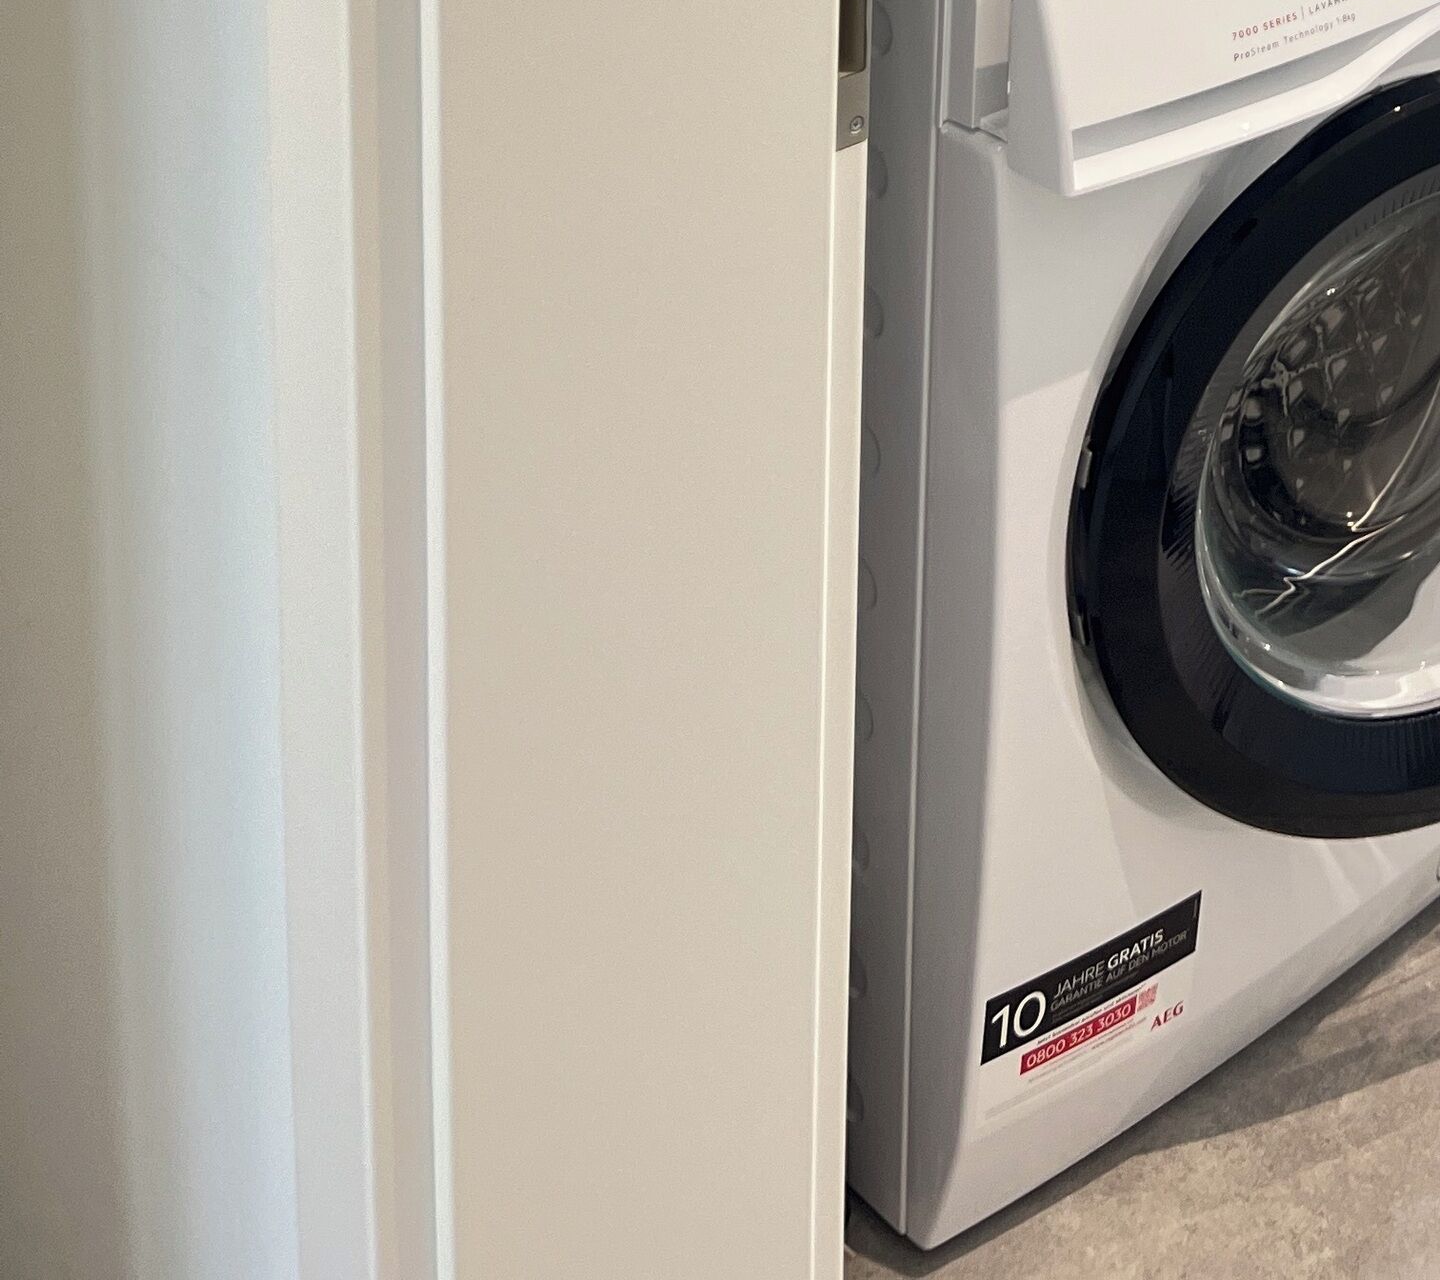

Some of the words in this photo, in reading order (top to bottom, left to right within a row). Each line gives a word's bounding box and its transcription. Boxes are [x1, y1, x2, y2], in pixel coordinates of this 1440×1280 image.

[1232, 25, 1259, 41] 7000
[1263, 12, 1298, 32] SERIES
[1233, 42, 1280, 62] ProSteam
[1284, 22, 1334, 45] Technology
[1051, 980, 1103, 1011] GARANTIE
[1105, 965, 1128, 983] AUF
[1128, 953, 1150, 971] DEN
[1152, 931, 1188, 959] MOTOR
[1053, 960, 1106, 999] JAHRE
[1107, 928, 1164, 970] GRATIS
[991, 991, 1046, 1049] 10
[1026, 1039, 1066, 1069] 0800
[1069, 1024, 1094, 1047] 323
[1097, 1003, 1132, 1030] 3030
[1150, 1000, 1185, 1031] AEG
